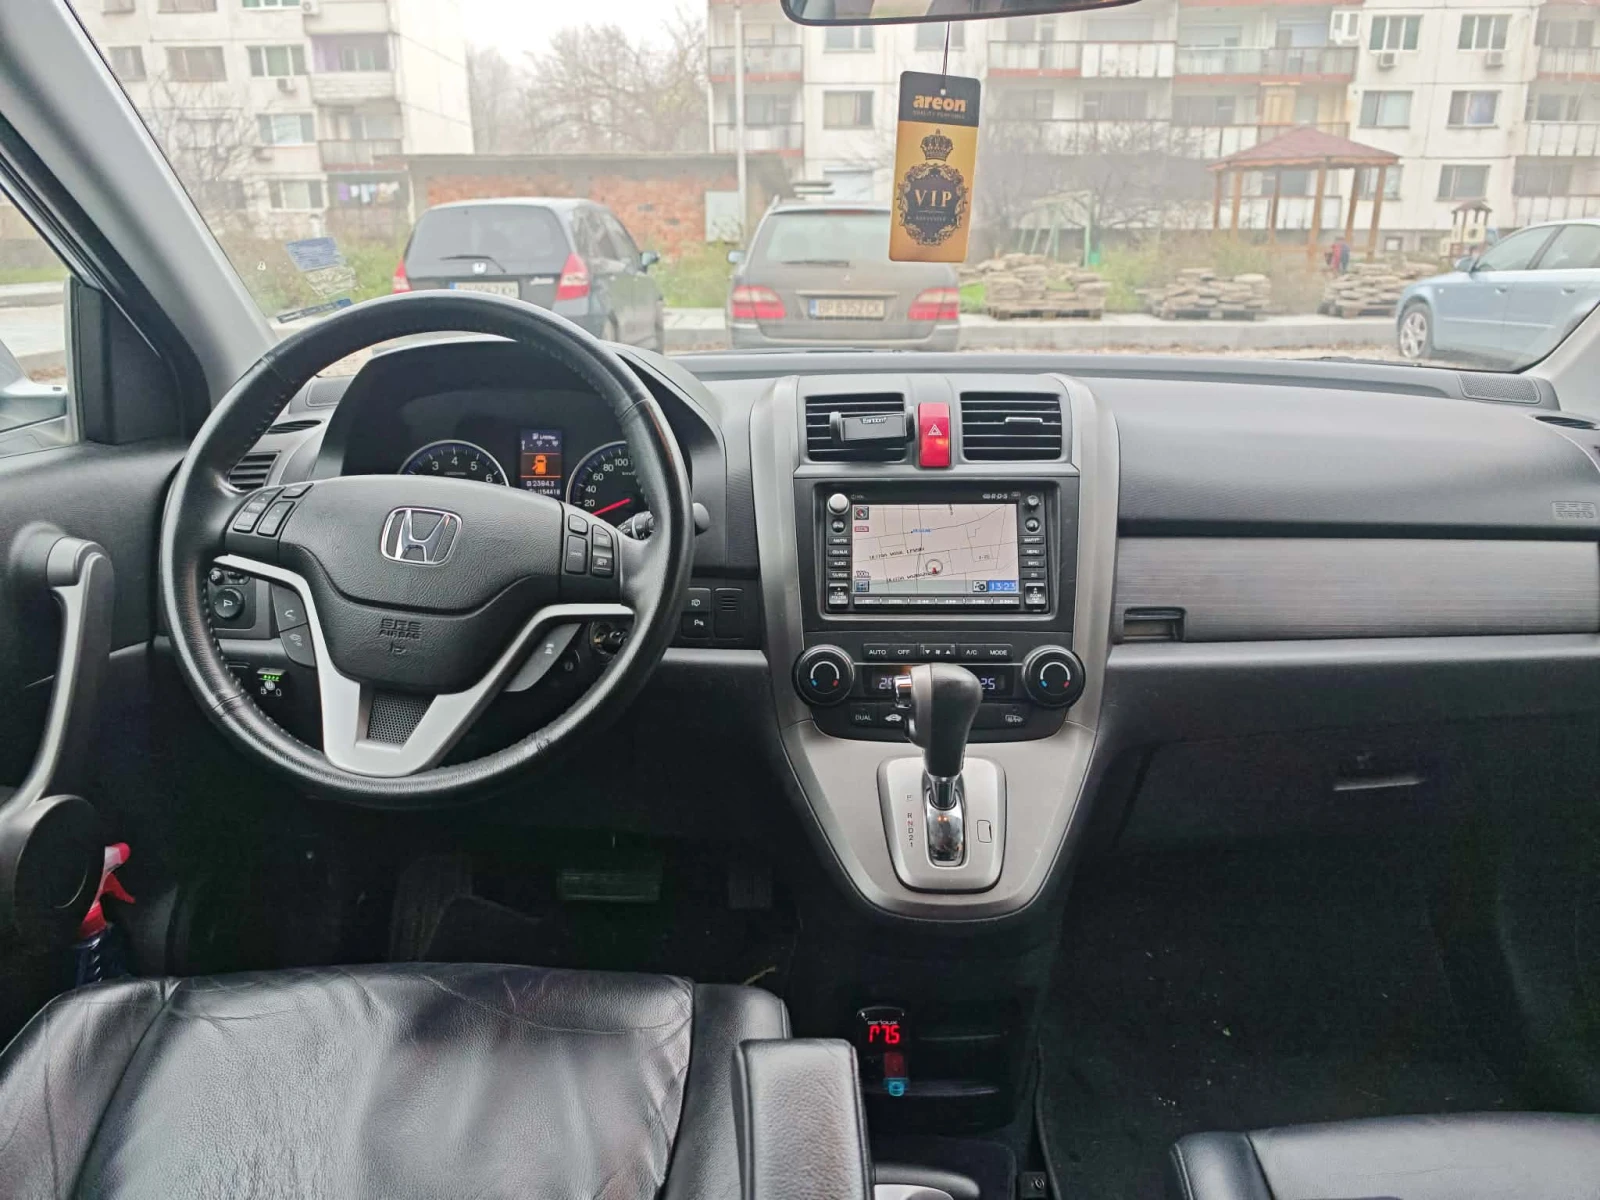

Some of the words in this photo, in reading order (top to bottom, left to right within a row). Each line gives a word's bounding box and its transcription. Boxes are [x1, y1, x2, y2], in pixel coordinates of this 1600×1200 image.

[913, 94, 966, 113] areon
[914, 189, 952, 208] VIP
[432, 461, 439, 471] 3
[451, 456, 458, 466] 4
[470, 461, 478, 471] 5
[614, 458, 629, 467] 100
[603, 463, 614, 472] 80
[485, 473, 493, 483] 6
[593, 473, 604, 481] 60
[585, 485, 597, 493] 40
[584, 499, 596, 507] 20
[381, 618, 421, 630] SRS
[380, 629, 420, 640] AIRBAG
